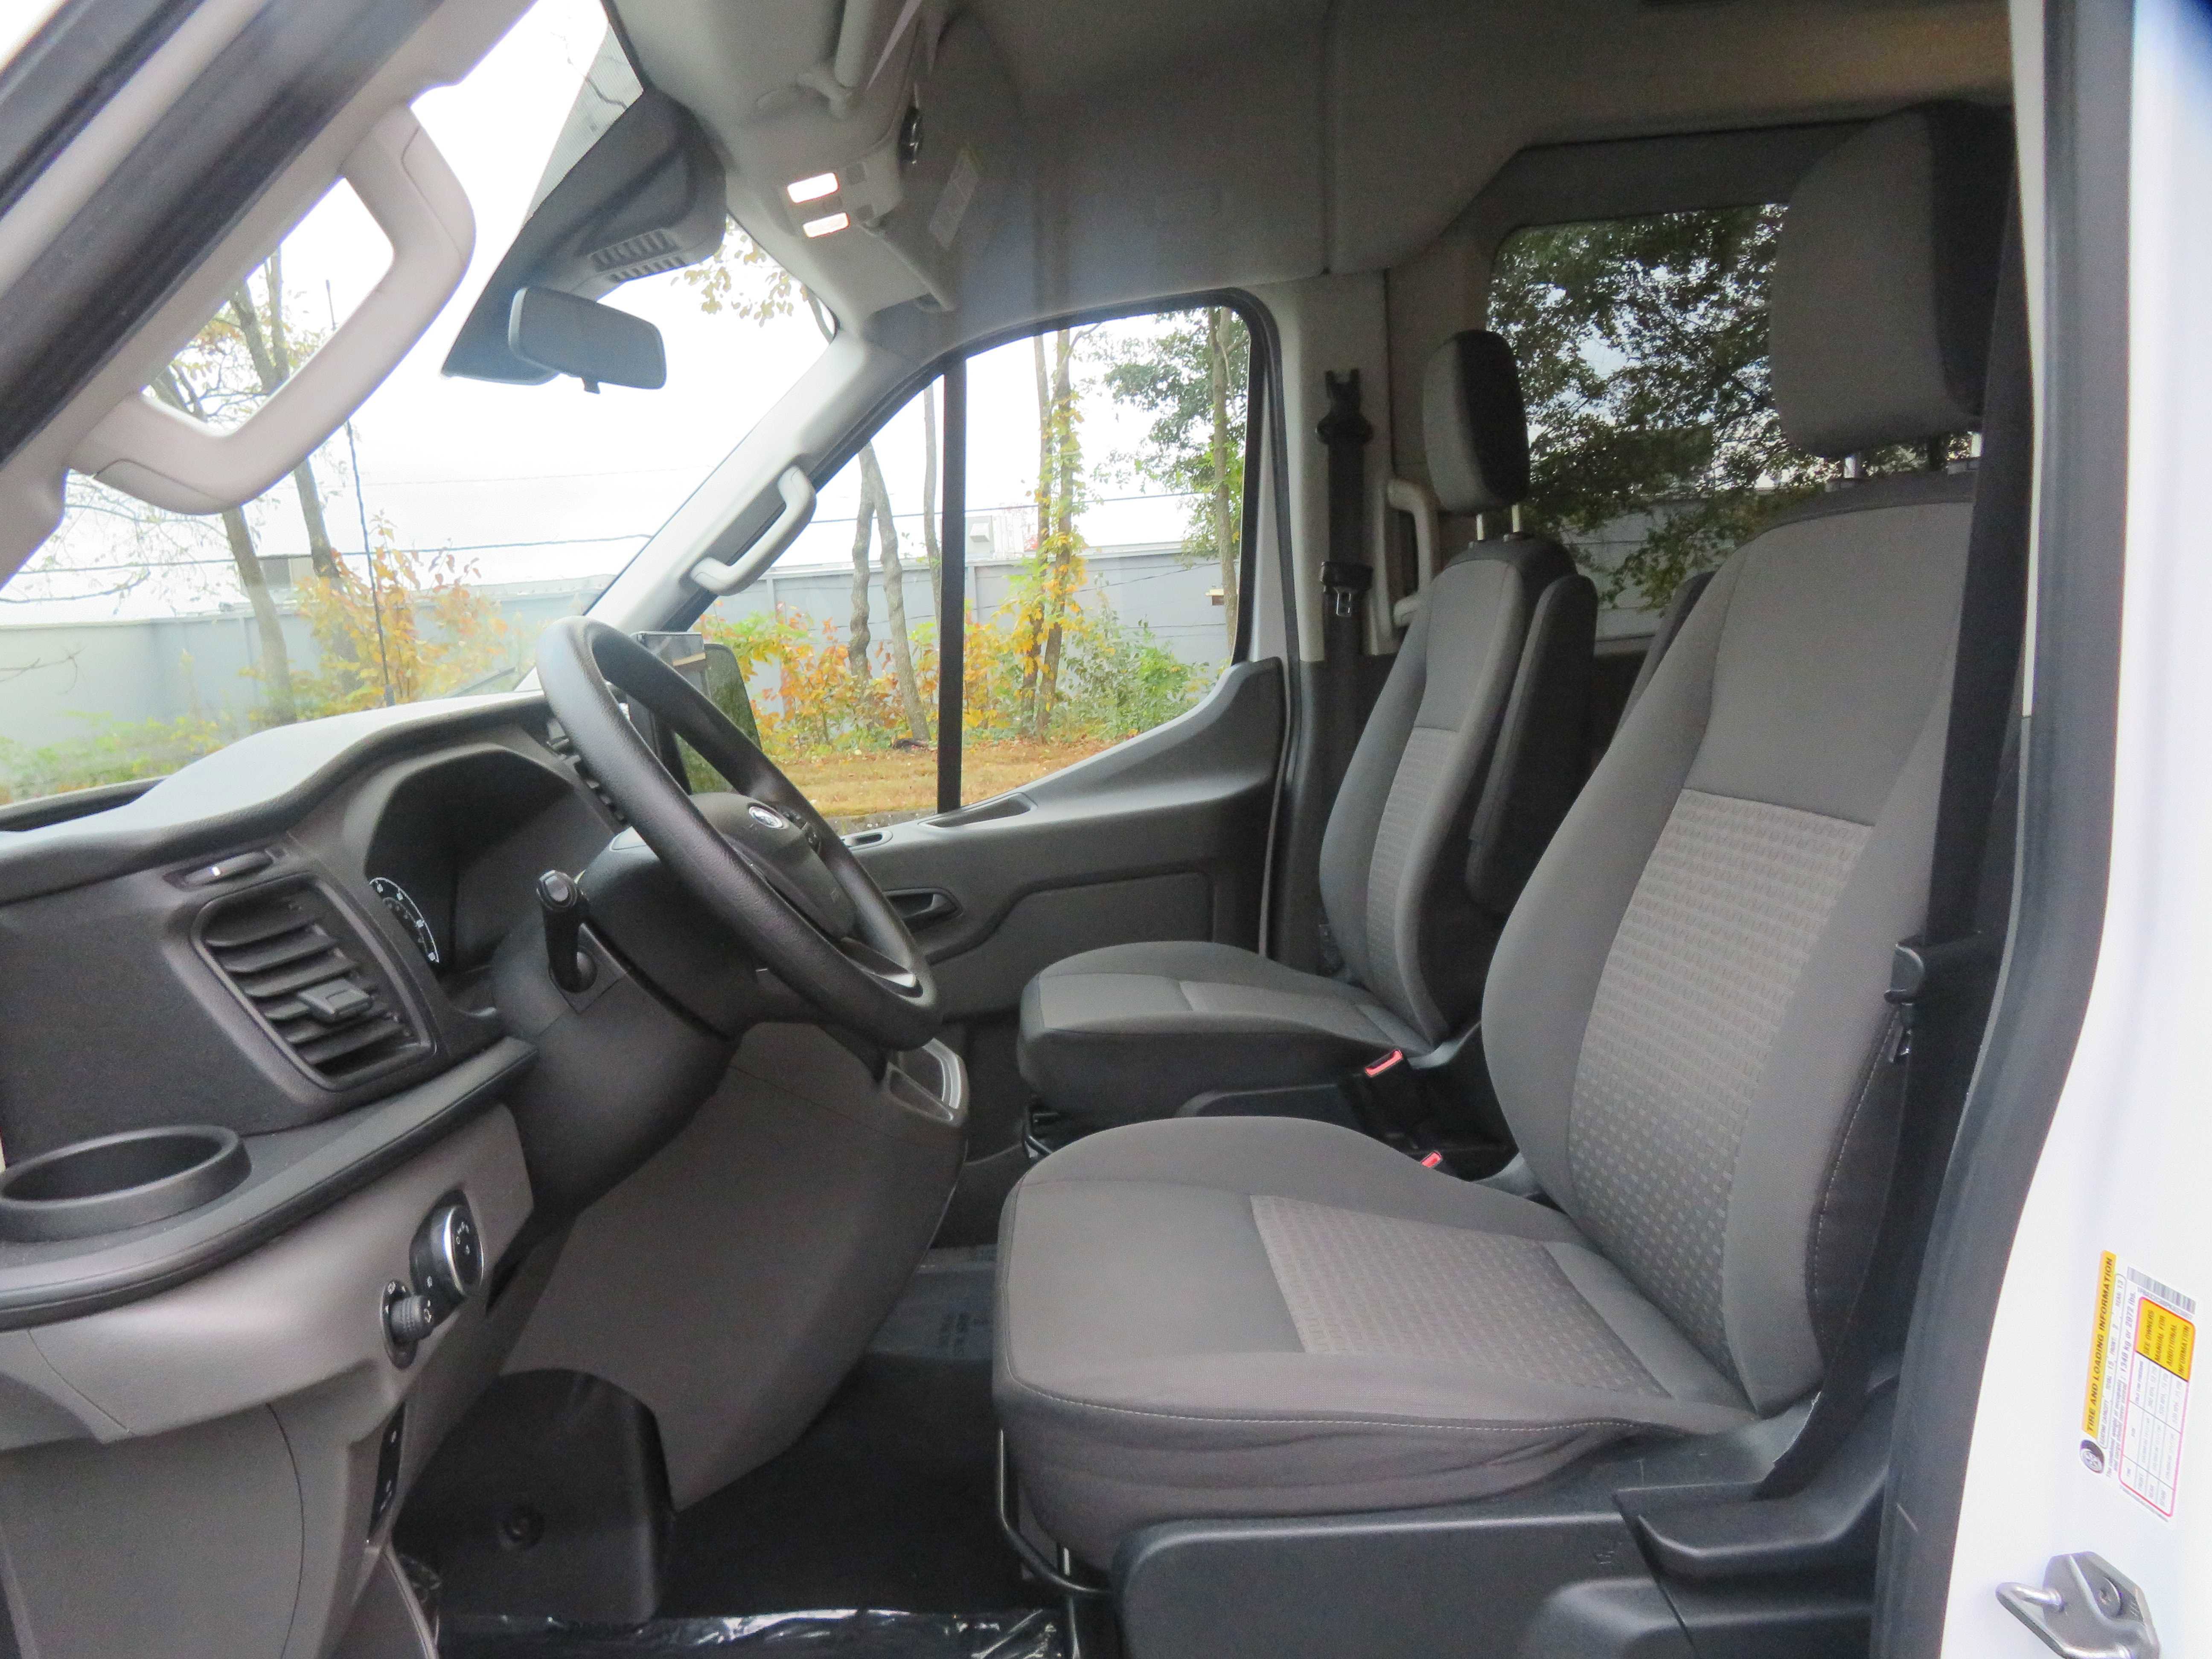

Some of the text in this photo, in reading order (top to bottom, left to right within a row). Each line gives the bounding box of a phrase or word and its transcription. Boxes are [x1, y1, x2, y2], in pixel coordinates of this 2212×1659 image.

[2087, 1257, 2113, 1433] TIRE AND LOADING INFORMATION
[2122, 1339, 2131, 1353] kg
[2125, 1329, 2131, 1339] or
[2154, 1315, 2166, 1362] MANUAL FOR
[2166, 1323, 2177, 1367] ADDITIONAL
[2177, 1324, 2190, 1377] INFORMATION
